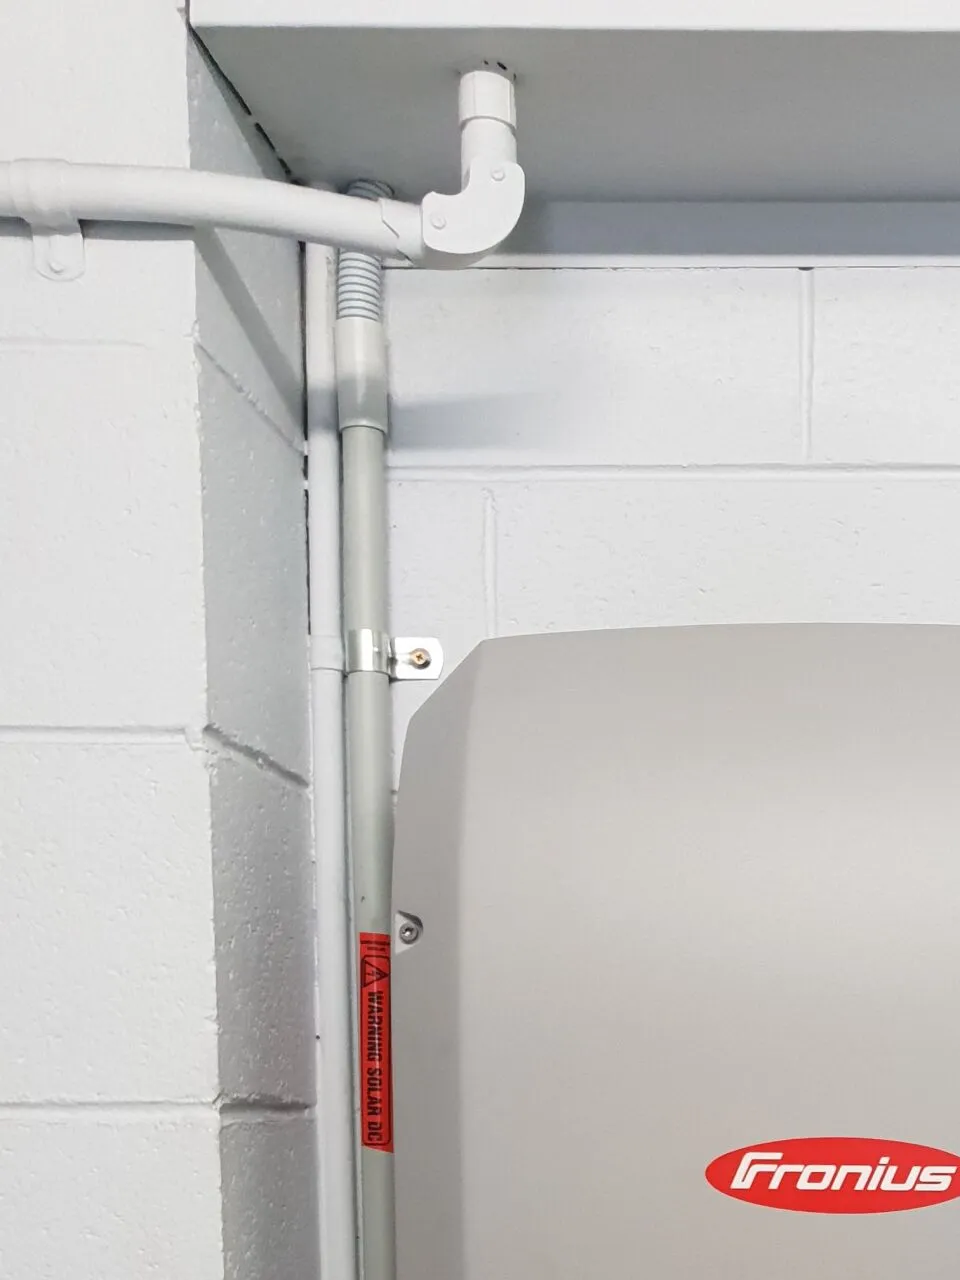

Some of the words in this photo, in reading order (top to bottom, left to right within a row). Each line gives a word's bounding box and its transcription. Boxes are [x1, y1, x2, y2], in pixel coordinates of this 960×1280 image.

[367, 991, 384, 1062] WARNING
[367, 1066, 383, 1116] SOLAR
[367, 1121, 383, 1142] DC
[730, 1151, 957, 1191] Fronius
